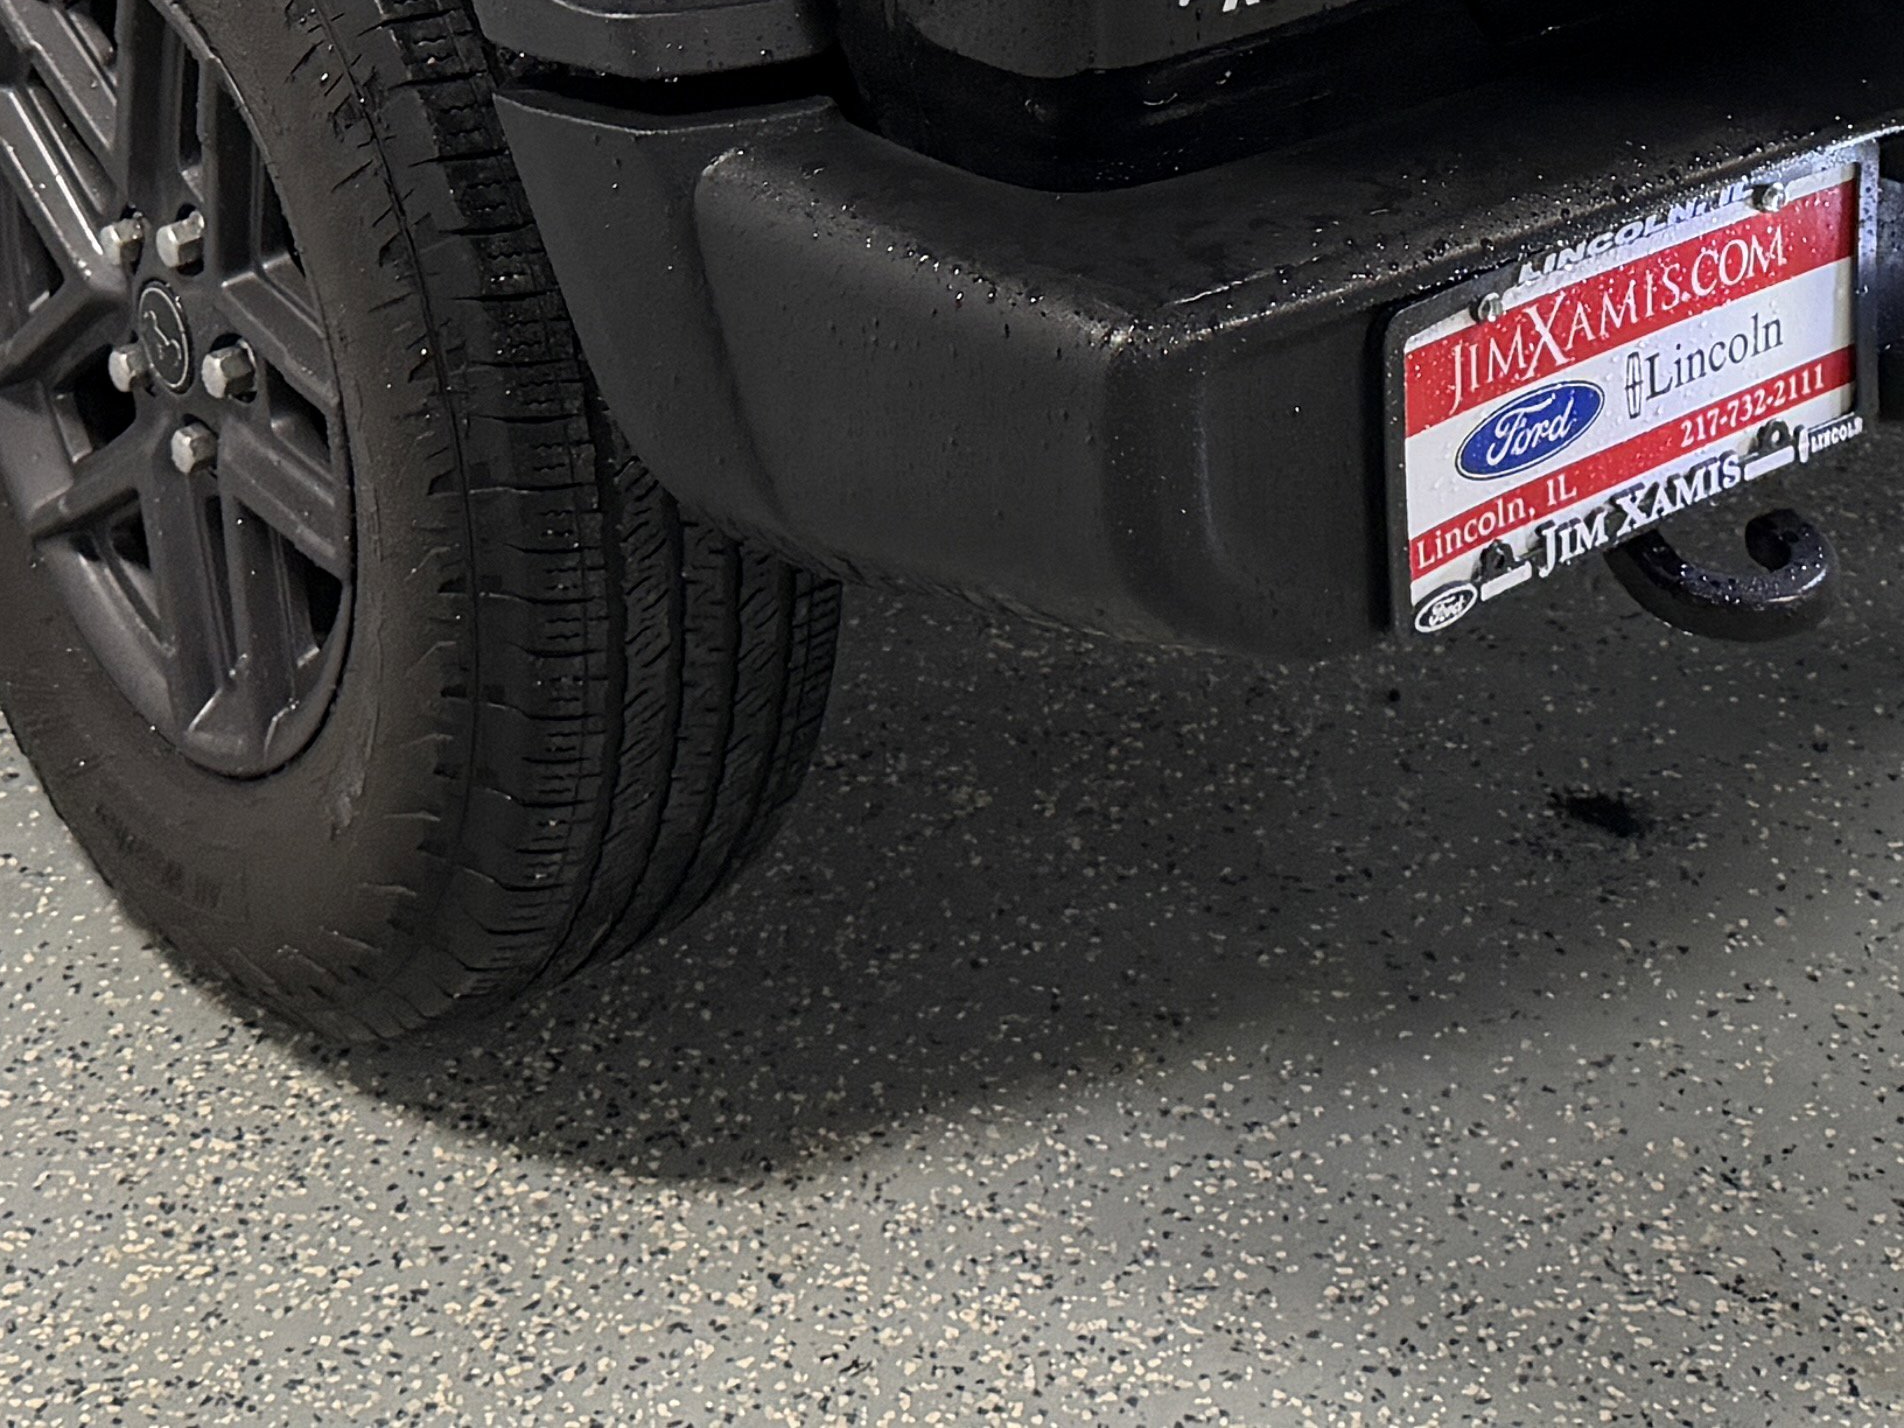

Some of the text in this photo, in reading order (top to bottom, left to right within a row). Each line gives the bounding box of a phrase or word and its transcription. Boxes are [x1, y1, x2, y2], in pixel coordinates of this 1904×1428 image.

[1645, 314, 1783, 402] Lincoln
[1486, 393, 1574, 467] Ford
[1679, 364, 1825, 449] 217-732-2111
[1415, 473, 1577, 570] Lincoln, IL
[1537, 454, 1742, 578] JIM XAMIS
